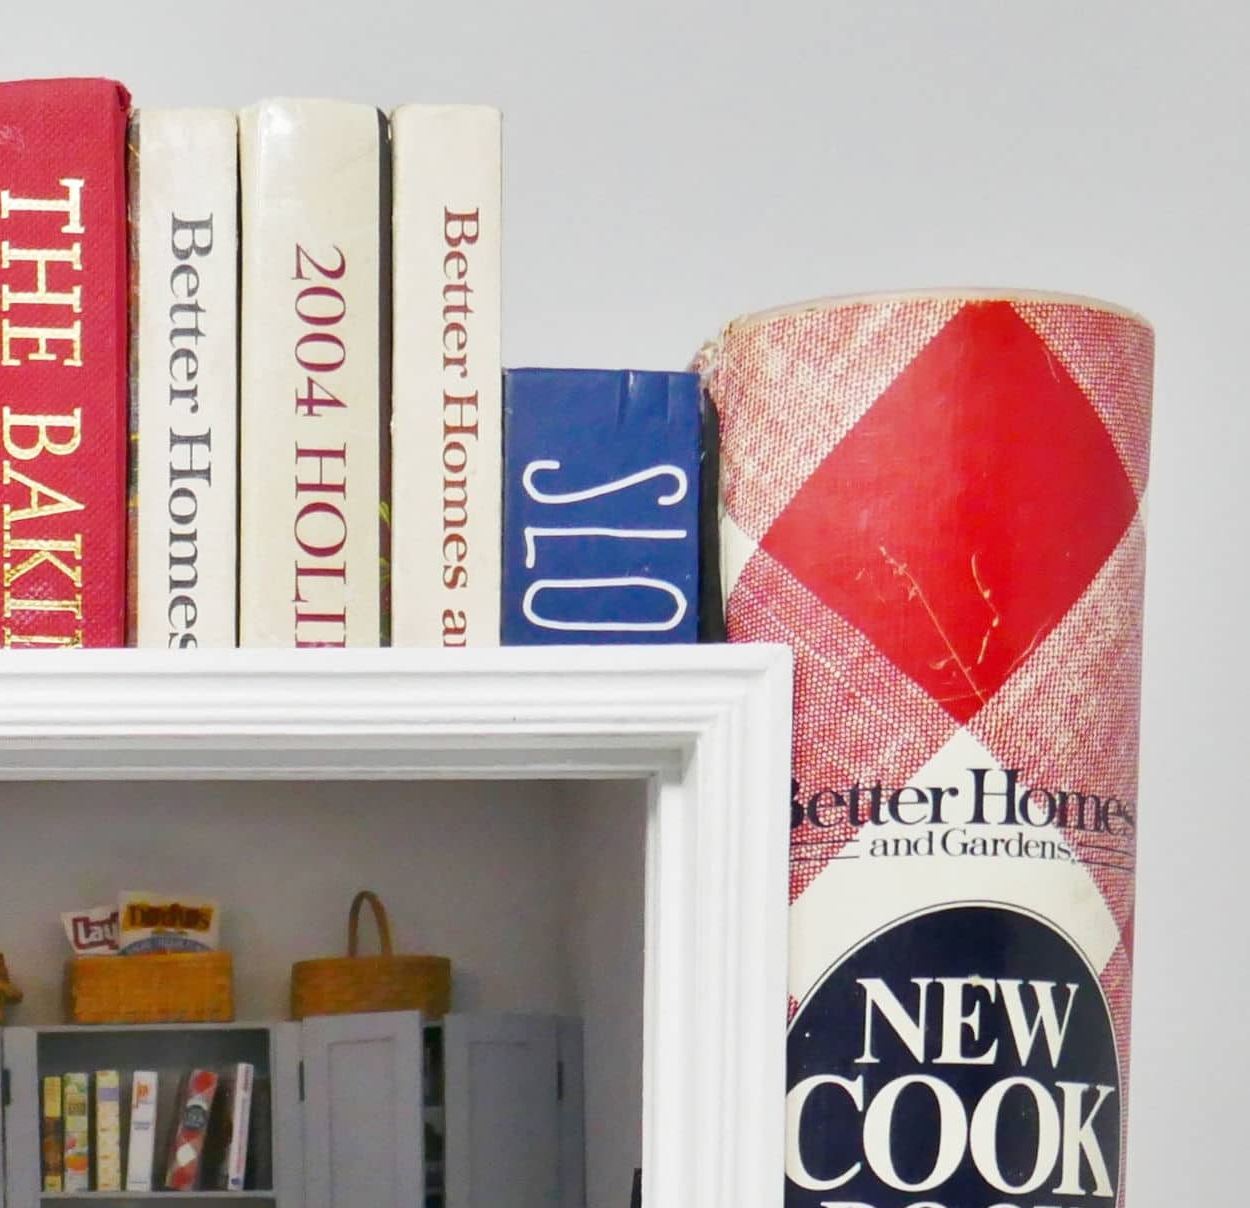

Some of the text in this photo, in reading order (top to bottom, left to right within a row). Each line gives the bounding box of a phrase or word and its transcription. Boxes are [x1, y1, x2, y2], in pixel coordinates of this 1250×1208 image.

[0, 178, 85, 367] THE
[168, 212, 214, 414] Better
[442, 206, 480, 378] Better
[292, 243, 348, 648] 2004 HOLI
[442, 390, 479, 590] Homes
[522, 460, 688, 631] SLO
[869, 830, 934, 857] and
[854, 976, 1079, 1068] NEW
[785, 1073, 1116, 1198] COOK
